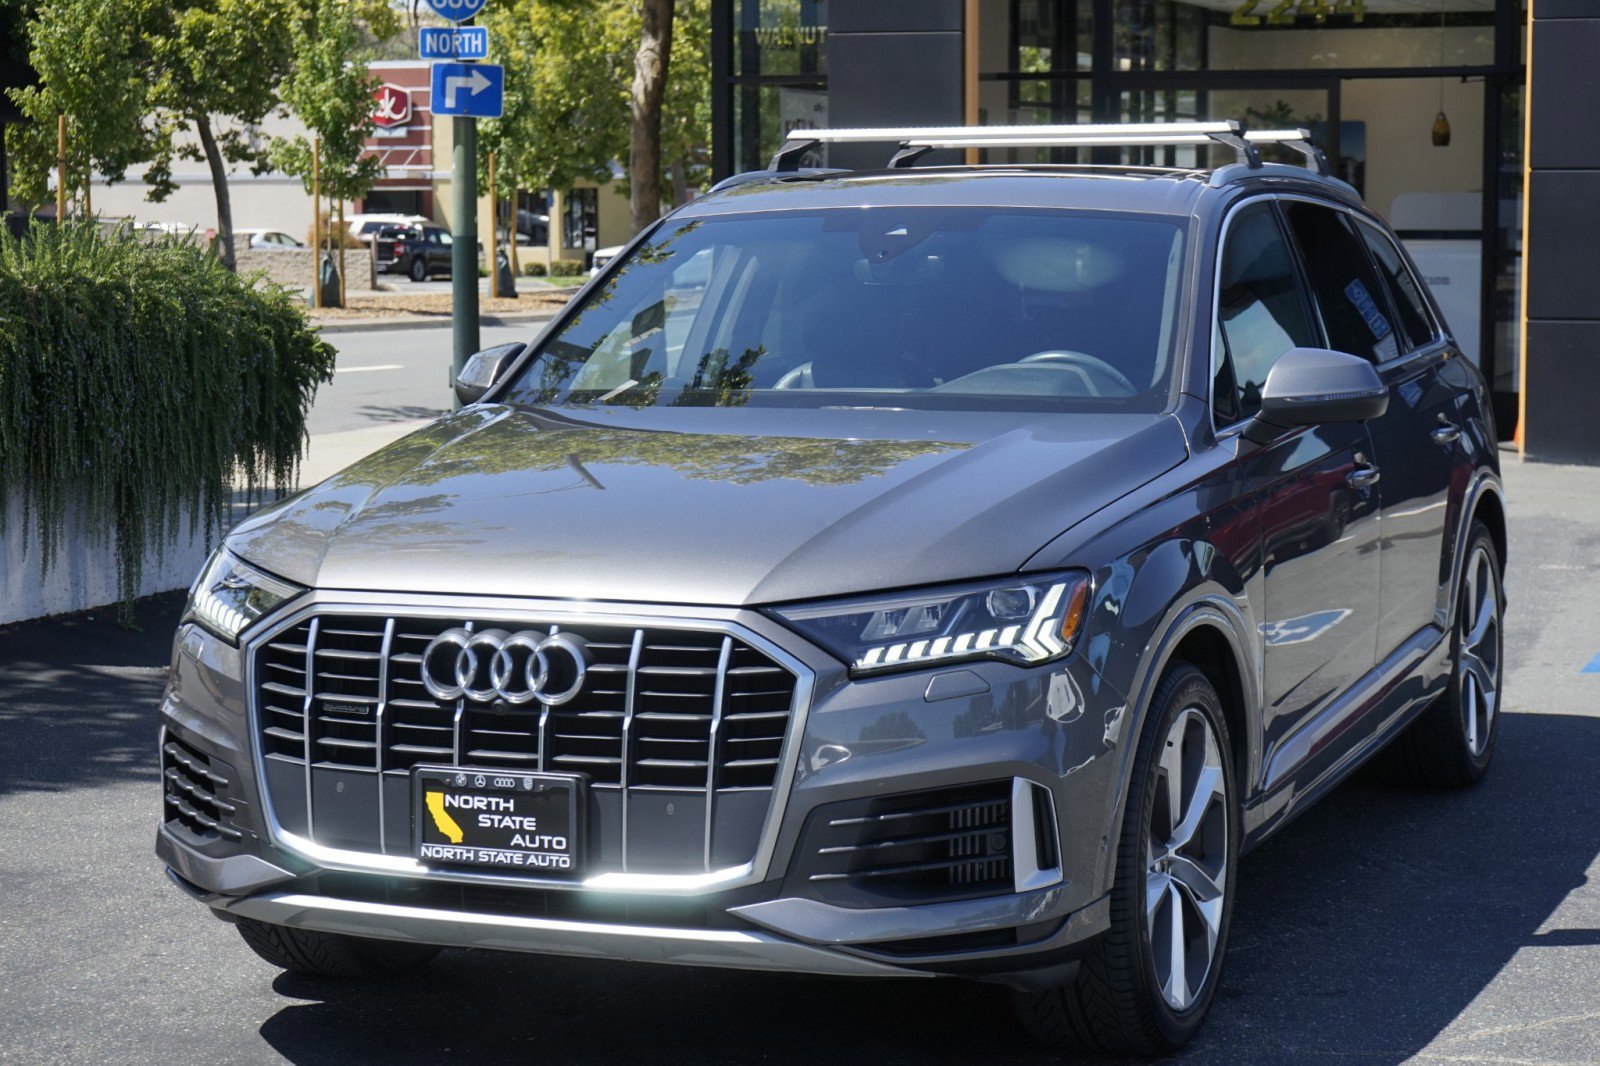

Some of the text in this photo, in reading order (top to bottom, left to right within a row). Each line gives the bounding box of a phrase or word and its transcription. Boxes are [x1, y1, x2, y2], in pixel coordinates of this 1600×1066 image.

[425, 32, 482, 54] NORTH
[444, 794, 514, 812] NORTH
[478, 814, 536, 831] STATE
[510, 833, 567, 850] AUTO
[420, 846, 571, 868] NORTH STATE AUTO
